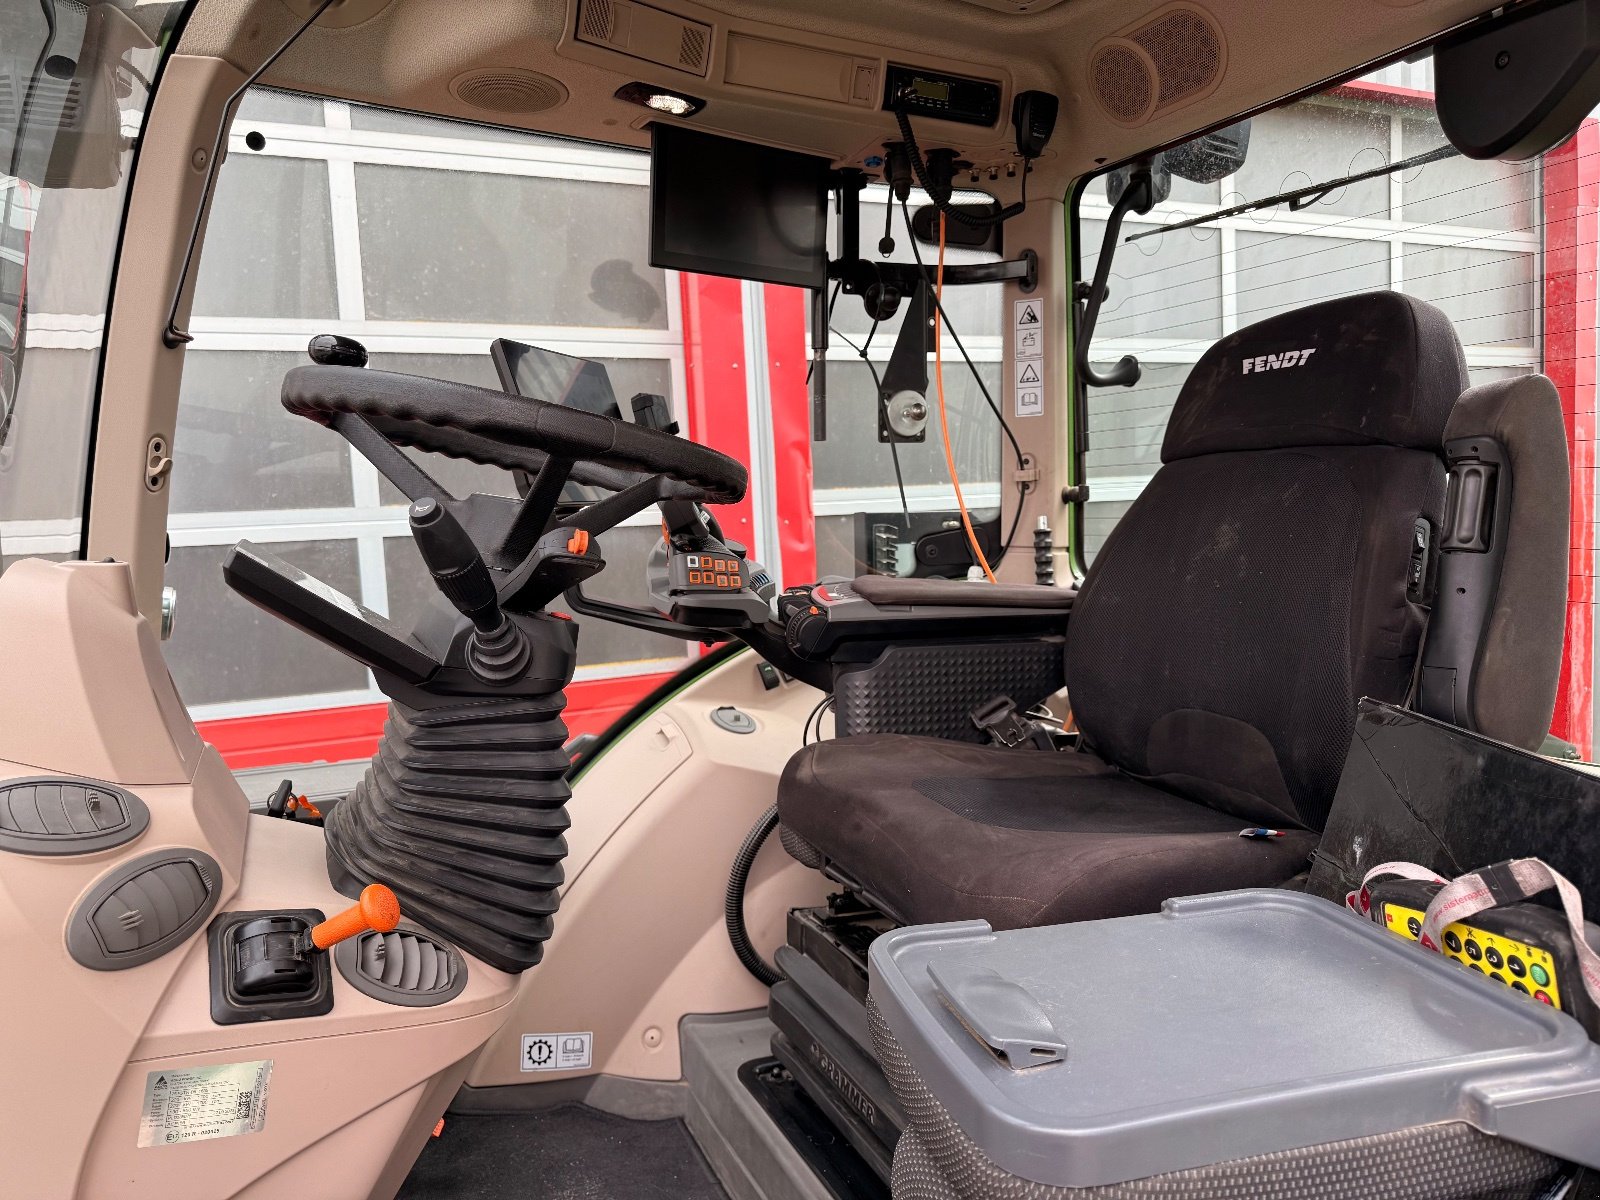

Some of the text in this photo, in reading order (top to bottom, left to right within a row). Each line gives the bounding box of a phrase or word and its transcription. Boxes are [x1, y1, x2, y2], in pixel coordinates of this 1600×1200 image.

[1242, 348, 1317, 375] FENDT
[1486, 952, 1498, 963] 3
[820, 1053, 875, 1124] GRAMMER
